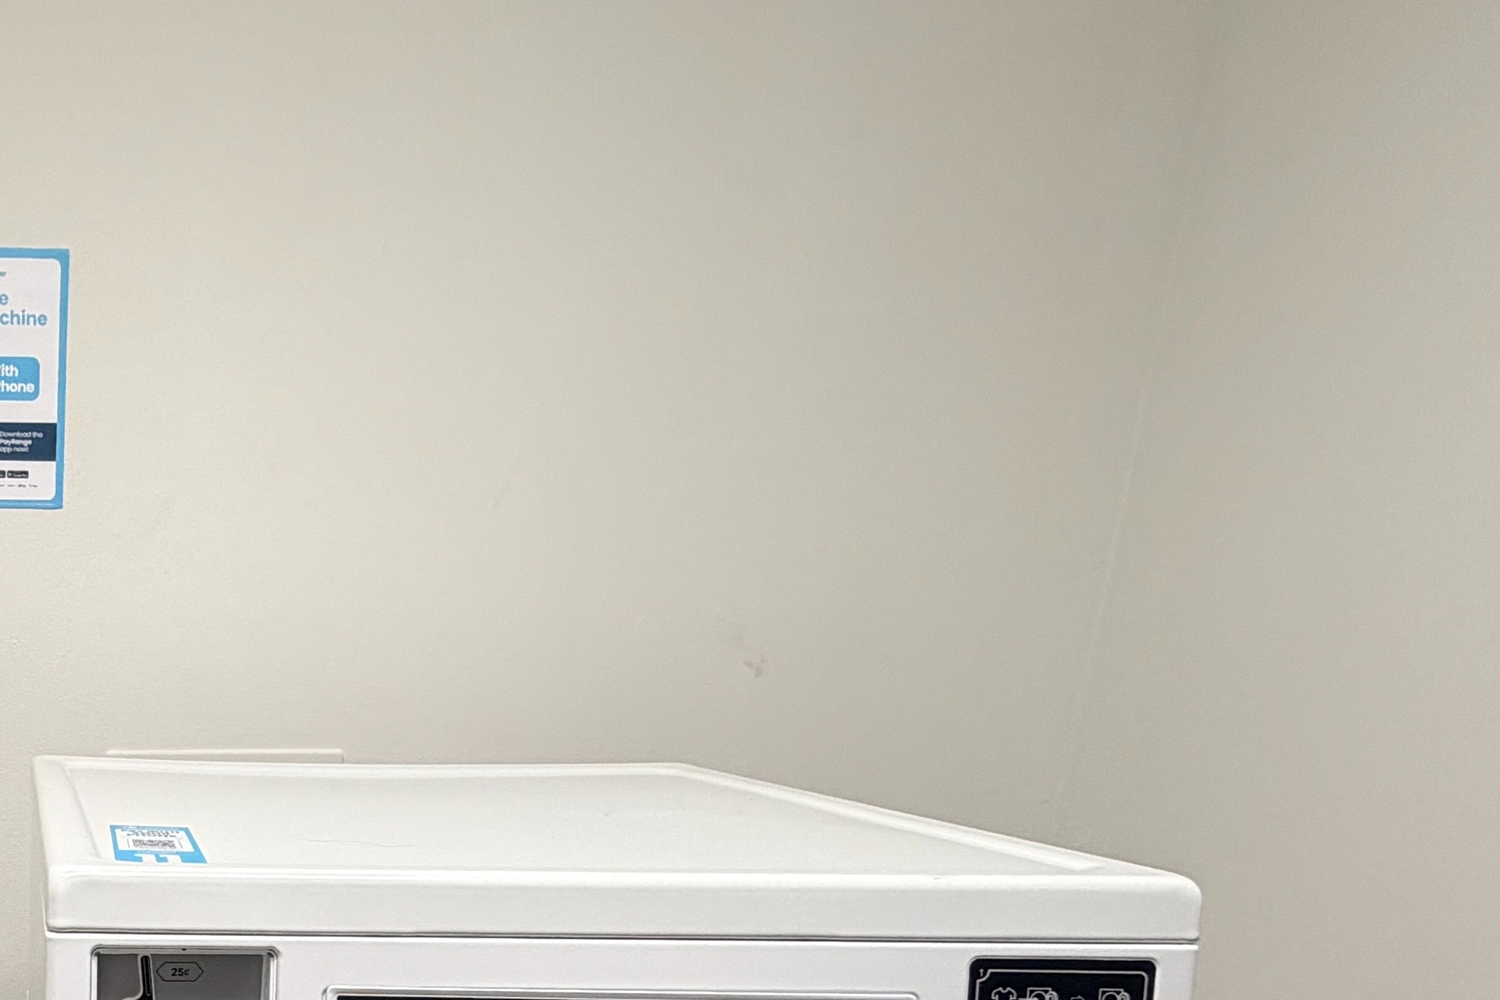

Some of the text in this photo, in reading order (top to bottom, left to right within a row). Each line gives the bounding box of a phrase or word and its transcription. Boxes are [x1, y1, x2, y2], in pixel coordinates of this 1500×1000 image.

[0, 439, 33, 447] PayRange
[170, 967, 190, 977] 25¢
[978, 968, 984, 977] 1
